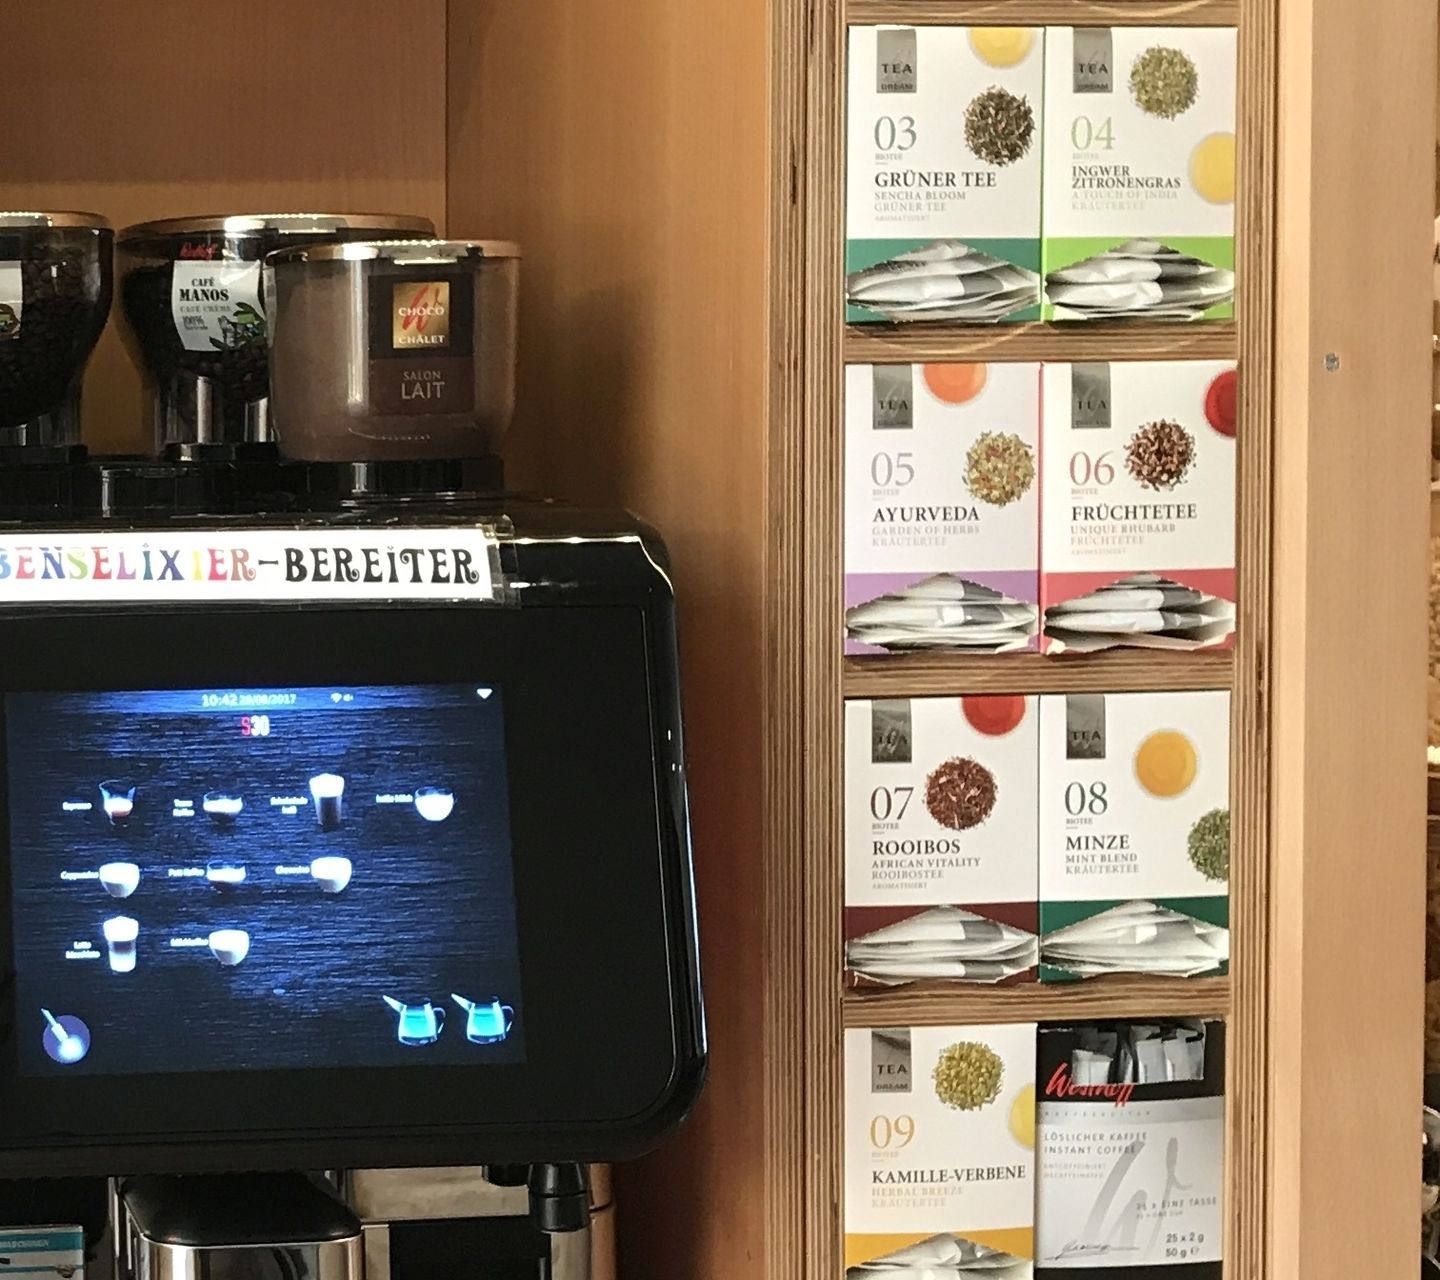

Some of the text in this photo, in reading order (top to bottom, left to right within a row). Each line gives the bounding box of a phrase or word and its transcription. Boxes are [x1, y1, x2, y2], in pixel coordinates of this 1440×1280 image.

[881, 63, 912, 74] TEA
[1078, 63, 1108, 74] TEA
[874, 115, 917, 151] 03
[1071, 115, 1116, 150] 04
[1072, 165, 1130, 177] INGWER
[874, 169, 997, 188] GRÜNER TEE
[1072, 177, 1181, 189] ZITRONENGRAS
[874, 191, 966, 200] SENCHA BLOOM
[1072, 190, 1178, 199] A TOUCH OF INDIA
[874, 201, 946, 212] GRÜNER TEE
[191, 277, 215, 287] CAFÉ
[180, 289, 230, 302] MANOS
[398, 307, 445, 317] CHOCO
[403, 371, 441, 381] SALON
[401, 381, 446, 400] LAIT
[871, 452, 915, 487] 05
[1070, 450, 1115, 486] 06
[873, 506, 980, 522] AYURVEDA
[1072, 502, 1197, 521] FRÜCHTETEE
[872, 525, 980, 535] GARDEN OF HERBS
[1071, 524, 1175, 535] UNIQUE RHUBARB
[870, 786, 915, 821] 07
[1065, 781, 1108, 816] 08
[872, 839, 961, 856] ROOIBOS
[1065, 834, 1130, 851] MINZE
[872, 857, 981, 869] AFRICAN VITALITY
[1065, 853, 1138, 863] MINT BLEND
[872, 870, 944, 880] ROOIBOSTEE
[1065, 864, 1140, 875] KRÄUTERTEE
[877, 1064, 908, 1075] TEA
[870, 1114, 915, 1149] 09
[1045, 1131, 1147, 1141] LÖSLICHER KAFFEE
[1045, 1145, 1135, 1155] INSTANT COFFEE
[872, 1165, 1026, 1184] KAMILLE-VERBENE
[872, 1186, 964, 1197] HERBAL BREEZE
[1166, 1233, 1178, 1243] 25
[1189, 1232, 1196, 1242] 2
[1198, 1233, 1205, 1243] g
[1165, 1247, 1187, 1258] 50 g
